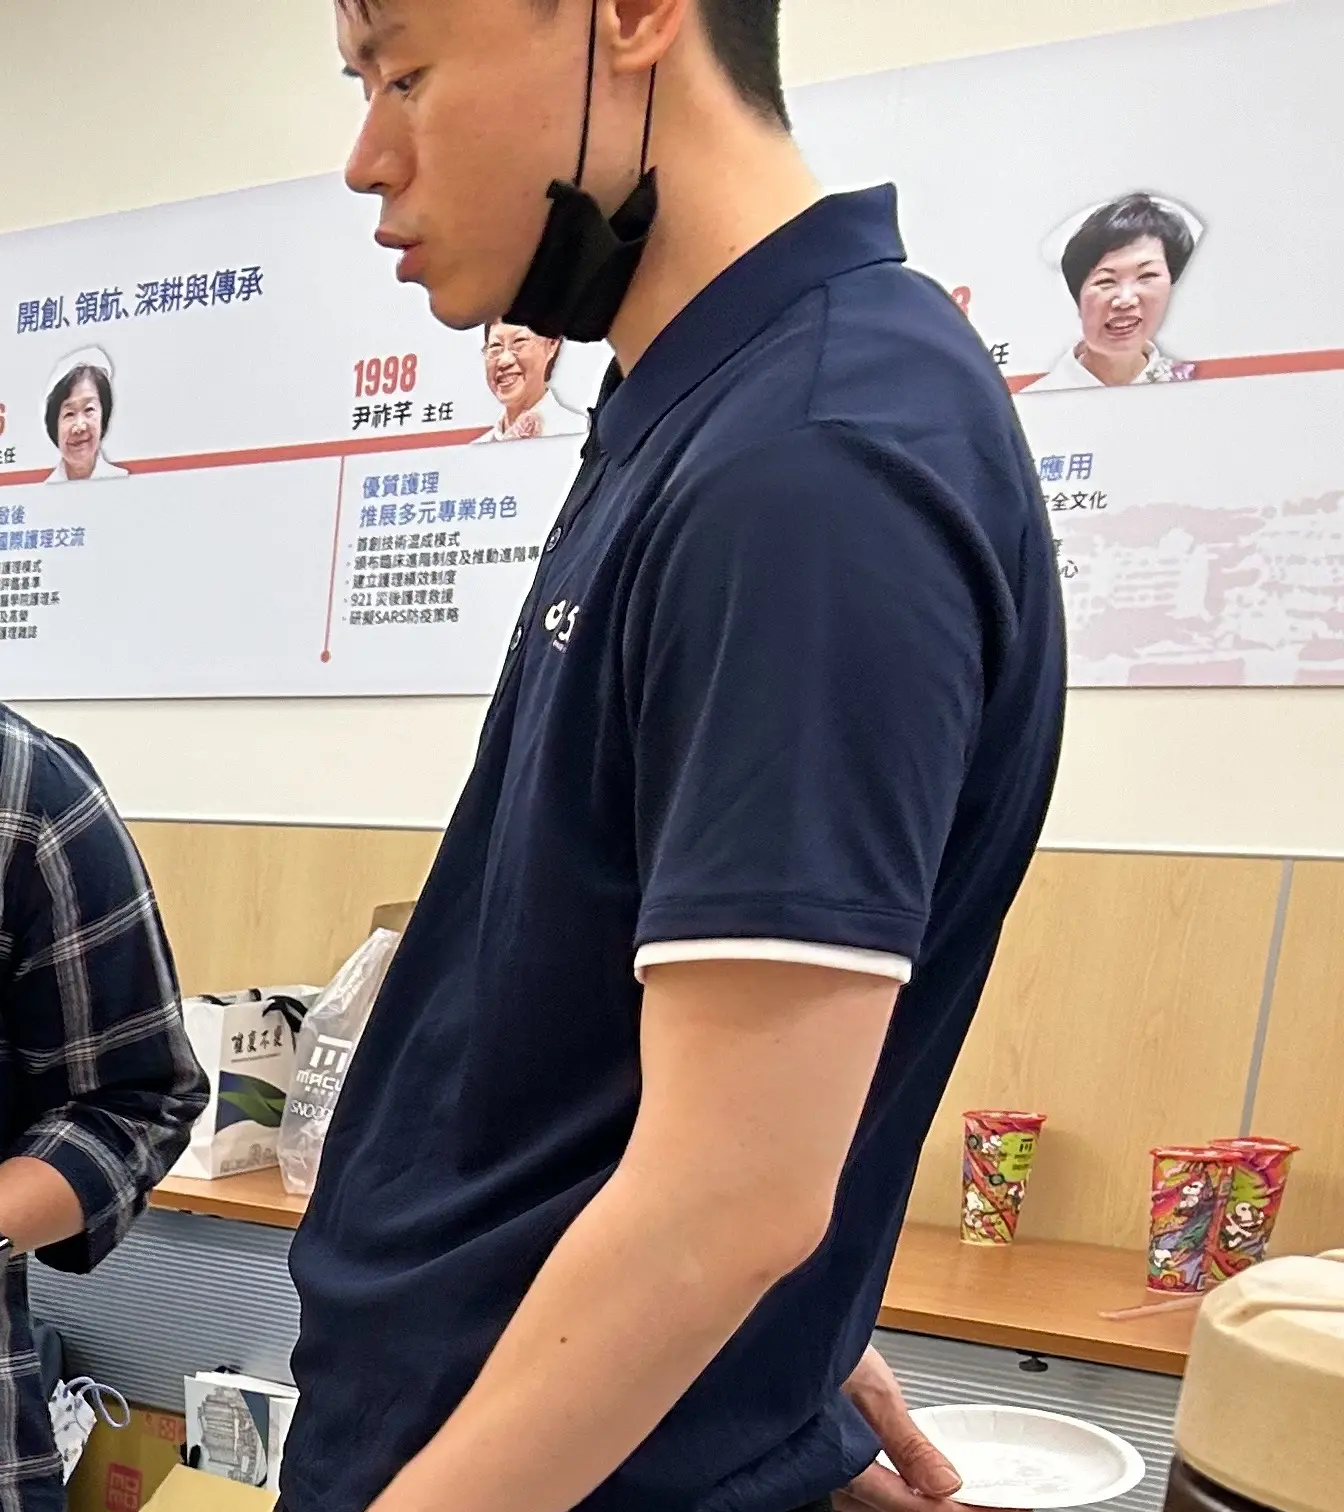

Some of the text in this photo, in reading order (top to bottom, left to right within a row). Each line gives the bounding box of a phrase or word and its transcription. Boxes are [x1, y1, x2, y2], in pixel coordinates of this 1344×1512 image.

[16, 265, 265, 334] 開創、領航、深耕與傳承
[354, 353, 417, 397] 1998
[421, 401, 454, 423] 主任
[362, 471, 440, 499] 優質護理
[359, 495, 518, 528] 推展多元專業角色
[350, 592, 372, 607] 921
